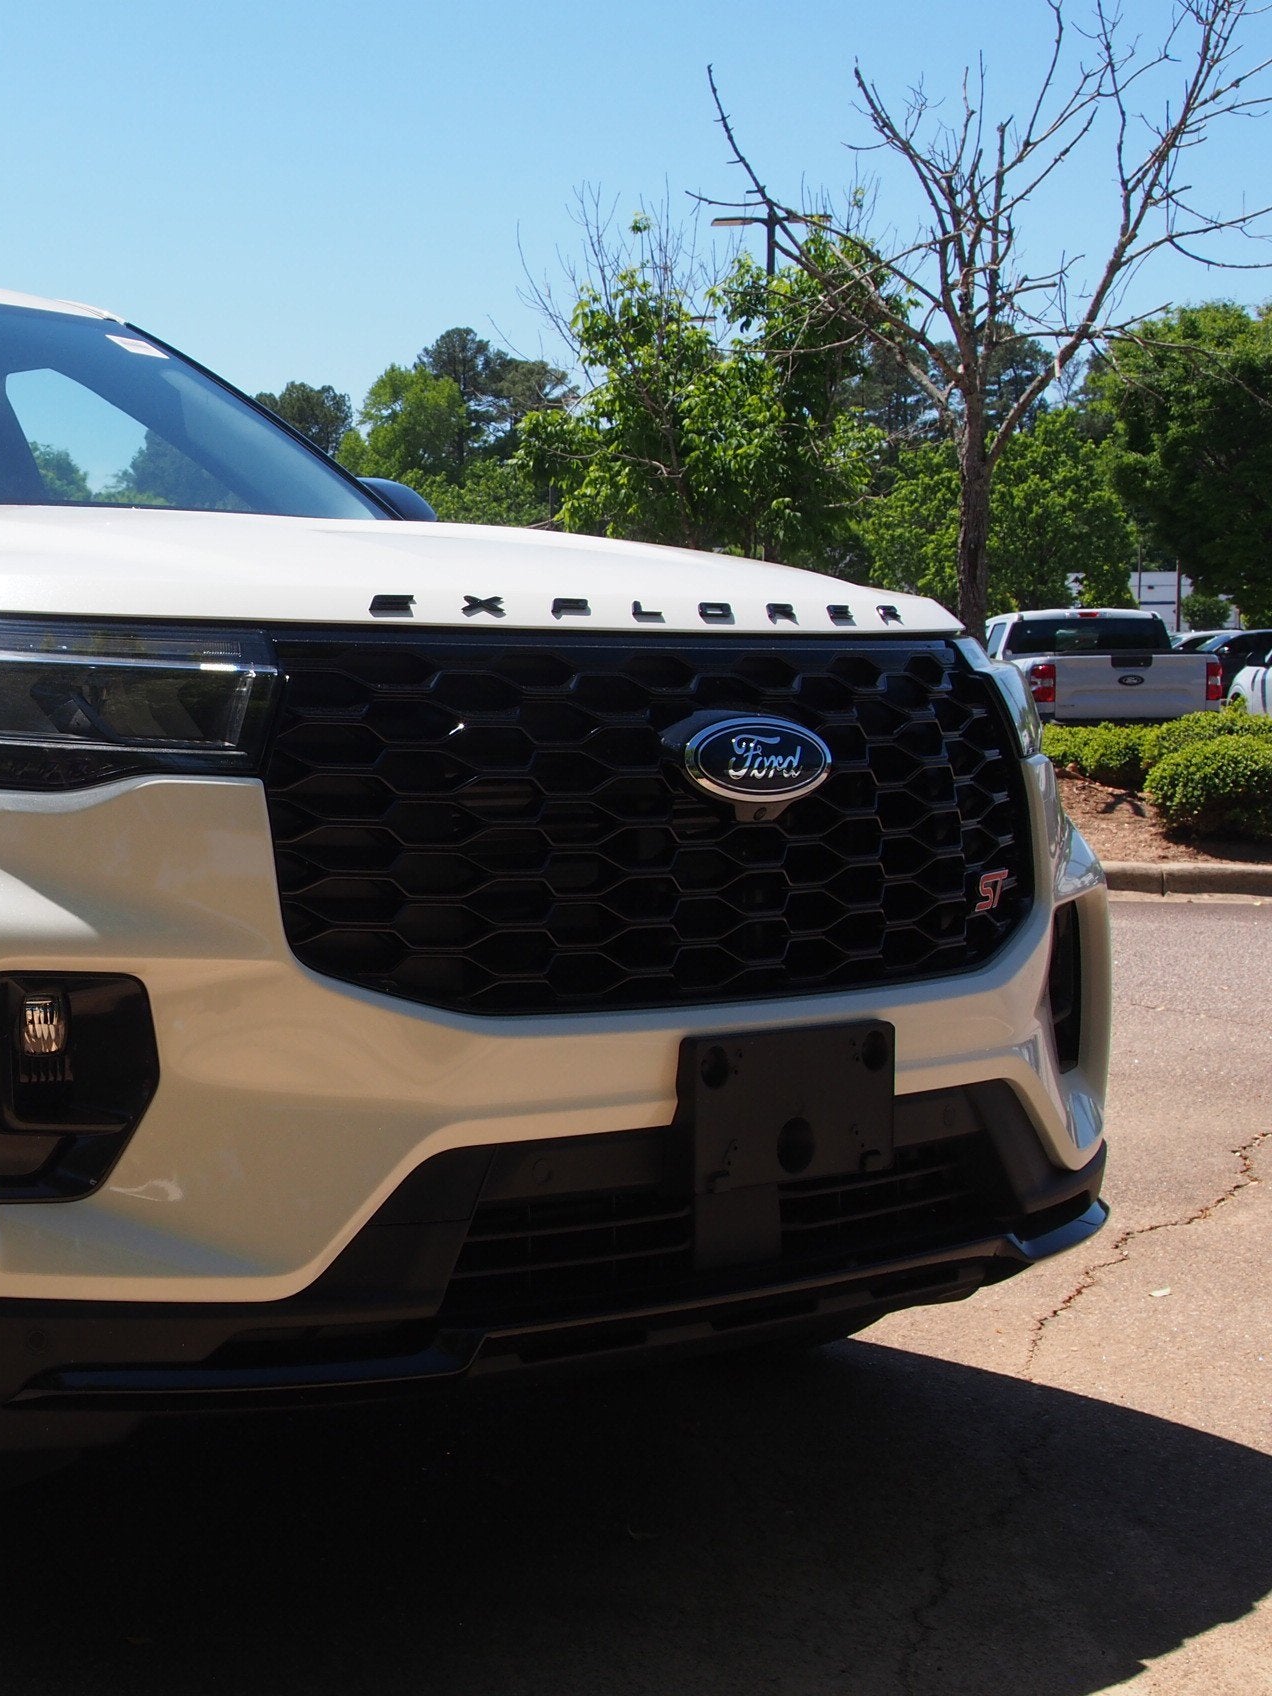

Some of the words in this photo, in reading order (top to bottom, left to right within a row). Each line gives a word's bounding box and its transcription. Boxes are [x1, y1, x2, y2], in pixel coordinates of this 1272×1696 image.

[369, 594, 902, 623] EXPLORER
[726, 733, 803, 781] Ford
[975, 869, 1009, 912] ST
